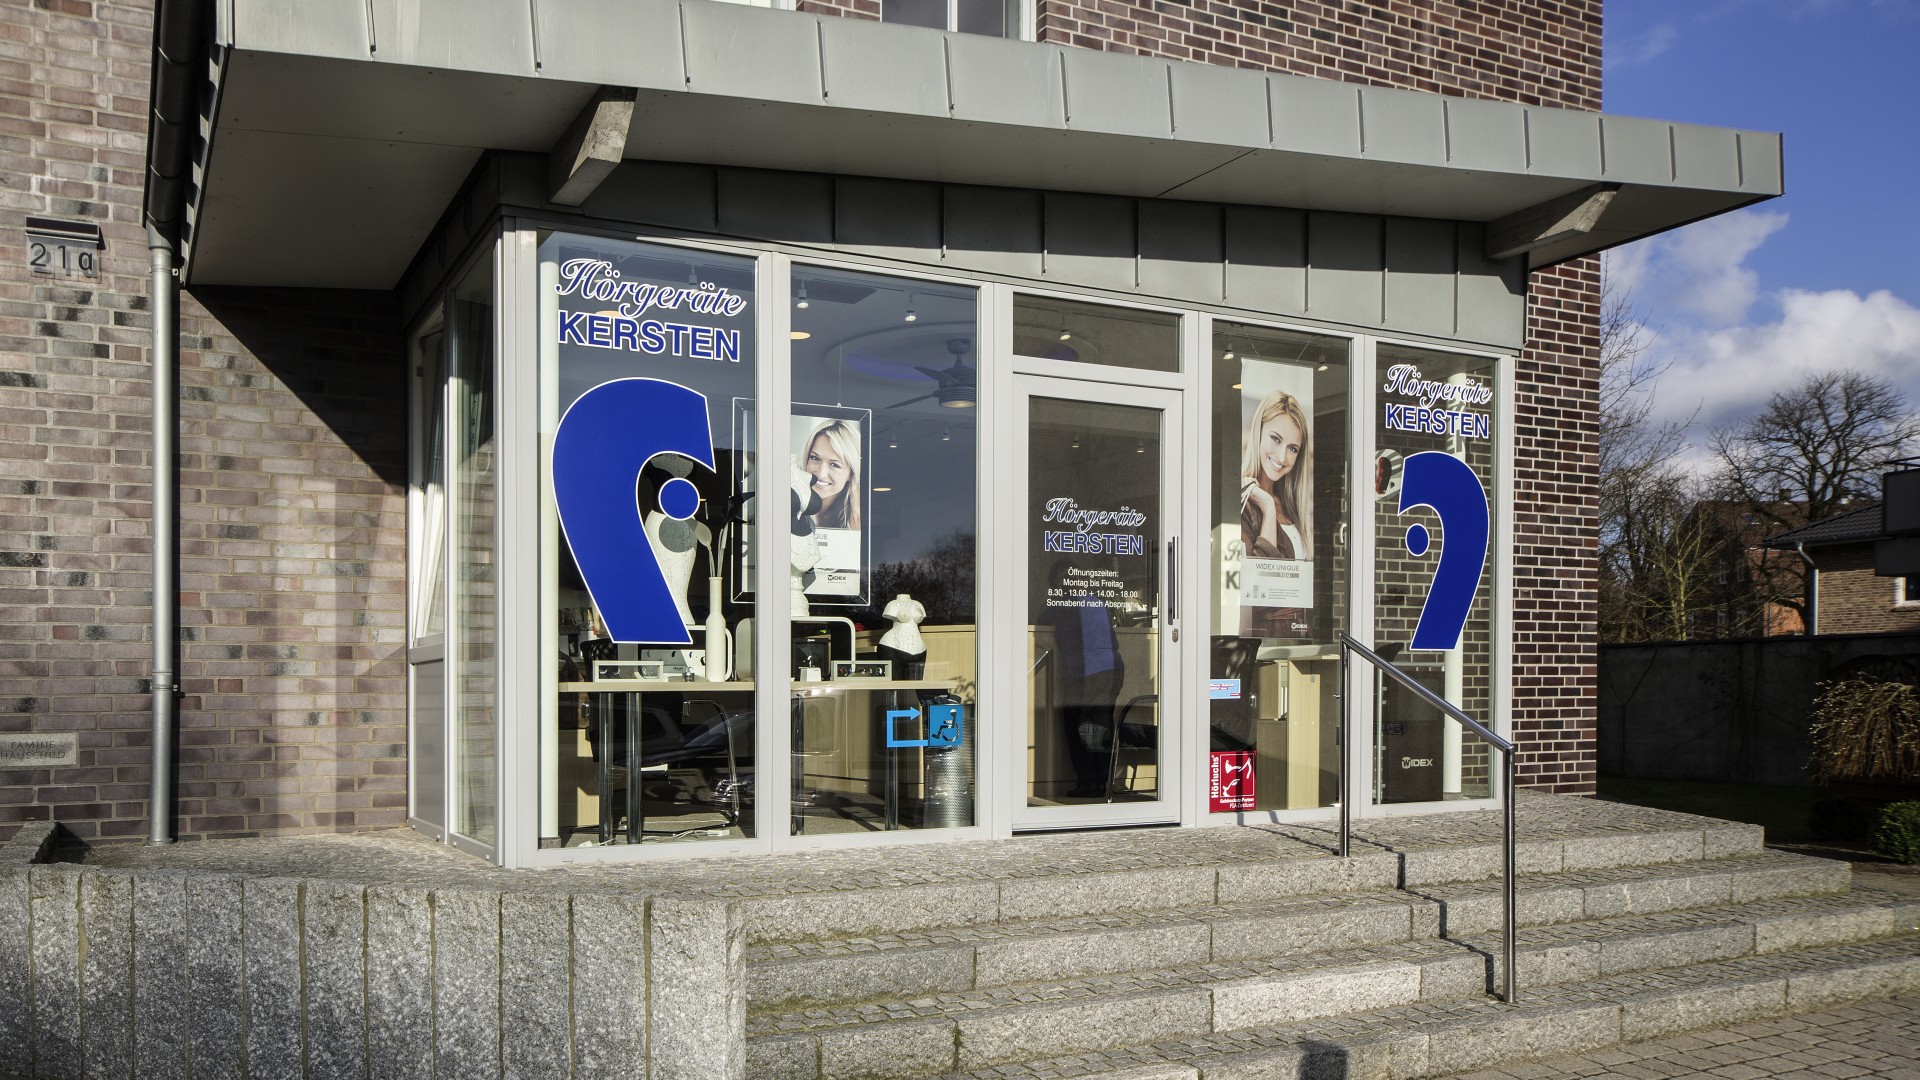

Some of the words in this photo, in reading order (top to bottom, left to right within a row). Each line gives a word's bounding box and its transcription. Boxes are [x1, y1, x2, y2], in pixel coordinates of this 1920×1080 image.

[30, 242, 93, 271] 21a
[555, 258, 747, 318] Hörgeräte
[558, 309, 740, 363] KERSTEN
[1384, 364, 1493, 408] Hörgeräte
[1385, 403, 1489, 439] KERSTEN
[1042, 497, 1147, 533] Hörgeräte
[1044, 530, 1143, 555] KERSTEN
[1067, 566, 1119, 578] Öffnungszeiten:
[1255, 563, 1275, 571] WIDEX
[1276, 564, 1300, 572] UNIQUE
[1047, 588, 1063, 597] 8.30
[1069, 589, 1087, 597] 13.00
[1097, 590, 1115, 598] 14.00
[1121, 590, 1138, 598] 18.00
[1063, 578, 1089, 588] Montag
[1090, 579, 1100, 587] bis
[1101, 579, 1124, 589] Freitag
[1046, 598, 1085, 607] Sonnabend
[1086, 600, 1103, 608] nach
[1104, 600, 1139, 609] Absprahe
[1402, 756, 1433, 769] WIDEX
